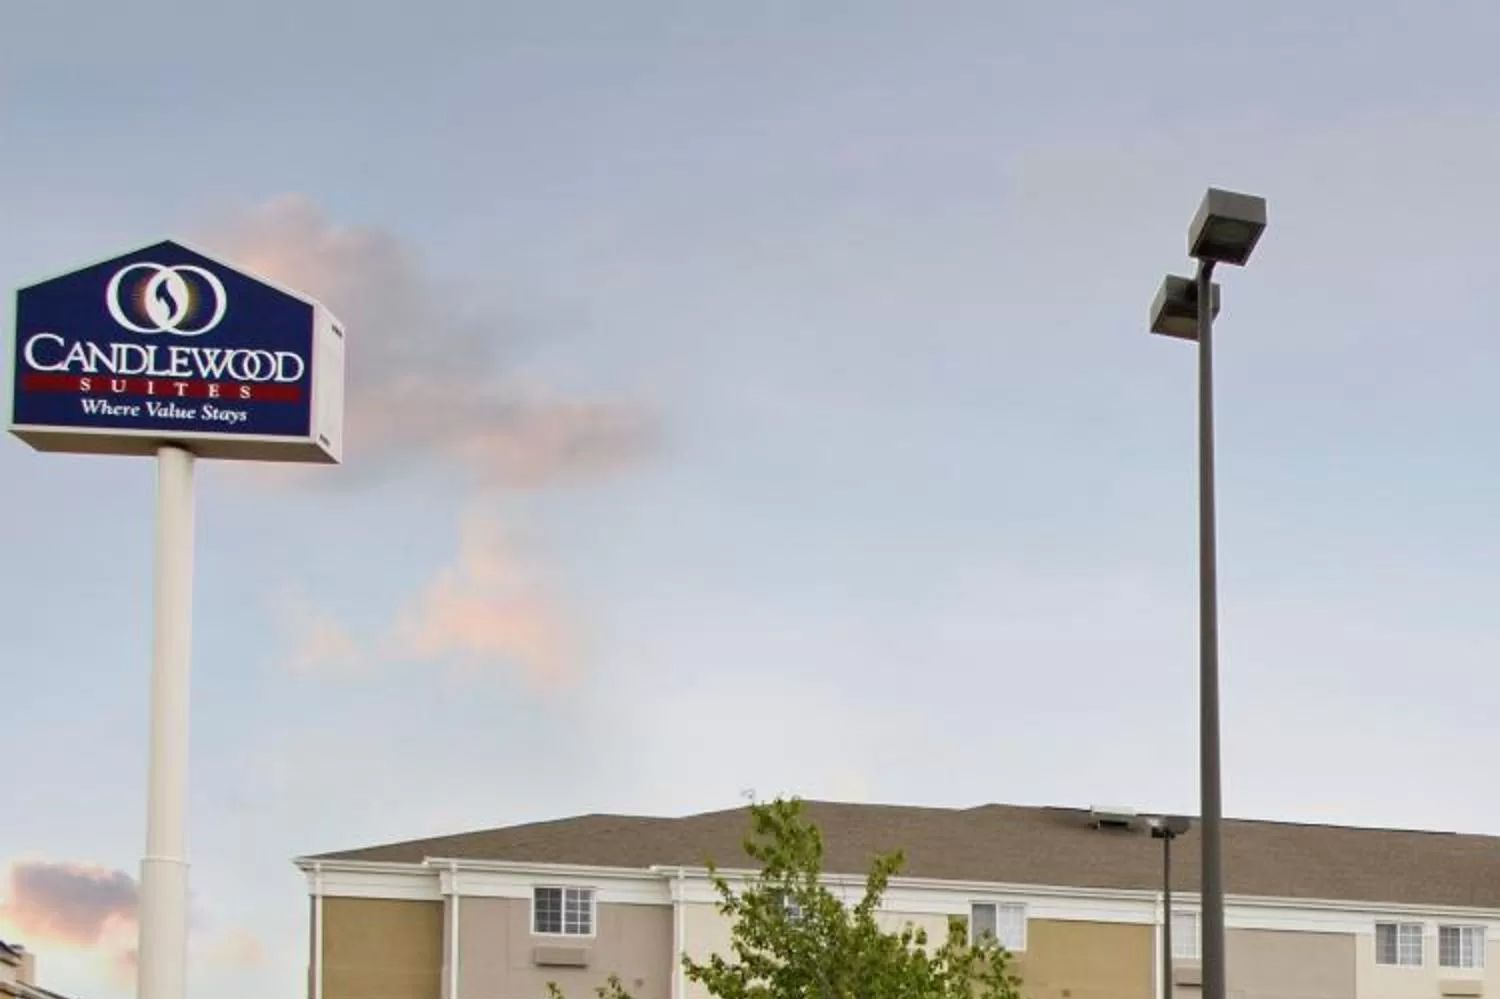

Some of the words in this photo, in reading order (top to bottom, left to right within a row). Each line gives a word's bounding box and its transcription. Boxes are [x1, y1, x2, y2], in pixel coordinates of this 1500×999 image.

[24, 332, 304, 382] CANDLEWOOD
[80, 377, 251, 399] SUITES
[80, 399, 140, 416] Where
[146, 401, 196, 418] Value
[201, 403, 247, 424] Stays
